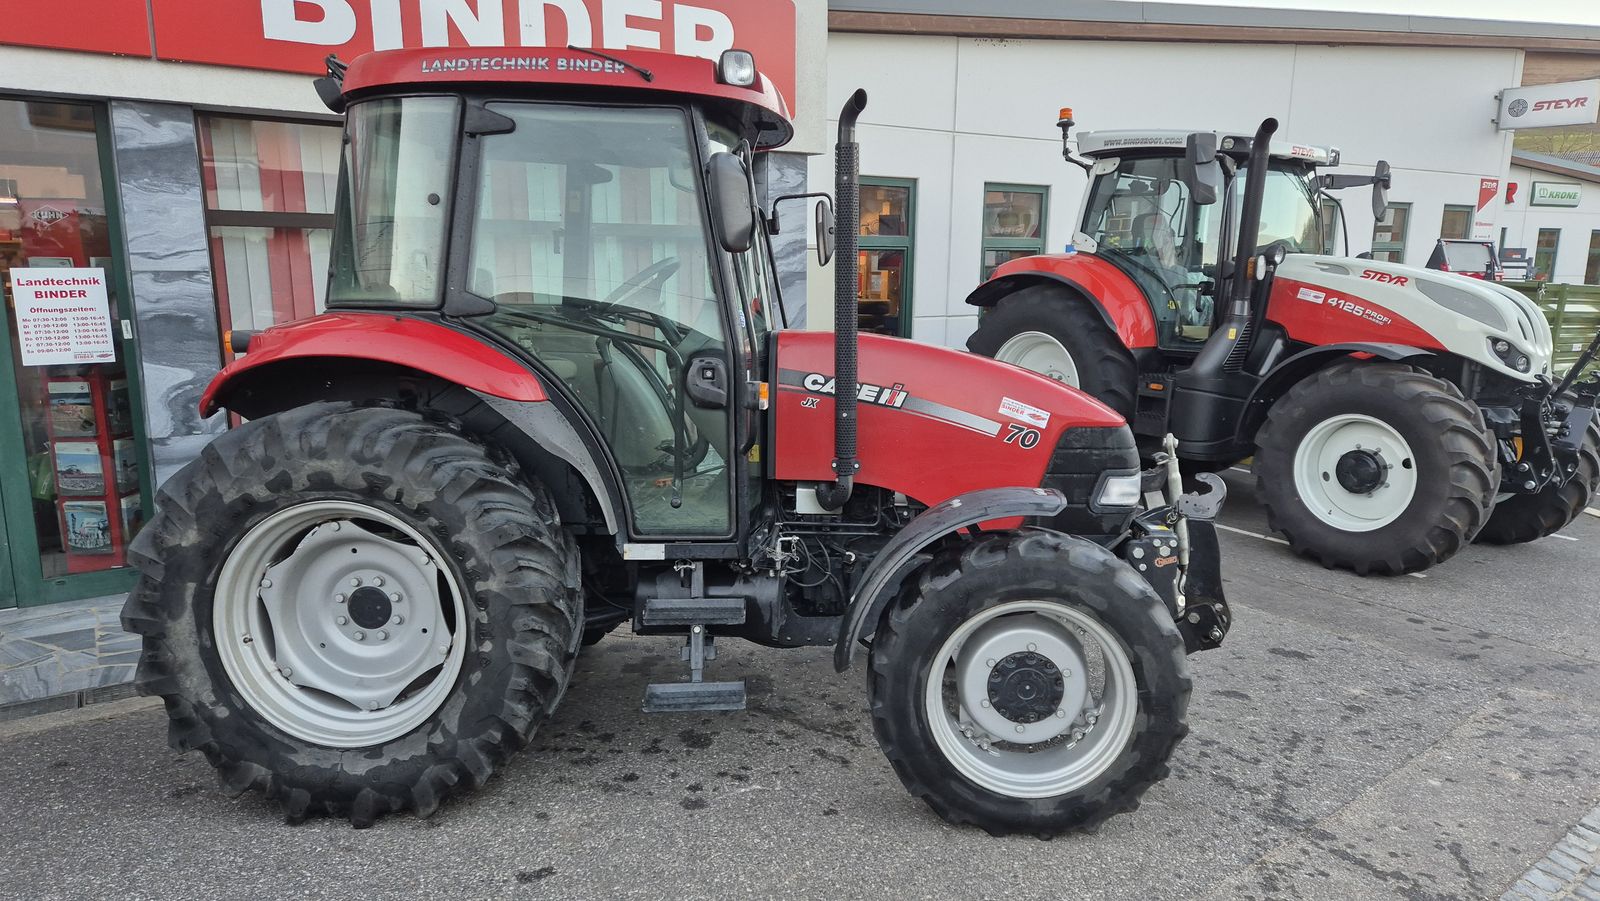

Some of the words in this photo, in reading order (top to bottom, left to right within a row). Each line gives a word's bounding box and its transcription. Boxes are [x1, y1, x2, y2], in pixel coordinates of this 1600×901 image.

[262, 0, 735, 62] BINDER
[421, 57, 549, 73] LANDTECHNIK
[557, 58, 625, 73] BINDER
[1532, 97, 1588, 111] STEYR
[1548, 190, 1578, 200] KRONE
[17, 277, 101, 287] Landtechnik
[1360, 269, 1409, 286] STEYR
[34, 290, 87, 299] BINDER
[1328, 297, 1364, 316] 4125
[1365, 309, 1391, 324] PROFI
[803, 373, 880, 402] CAE
[801, 397, 820, 409] JX
[1004, 423, 1041, 449] 70
